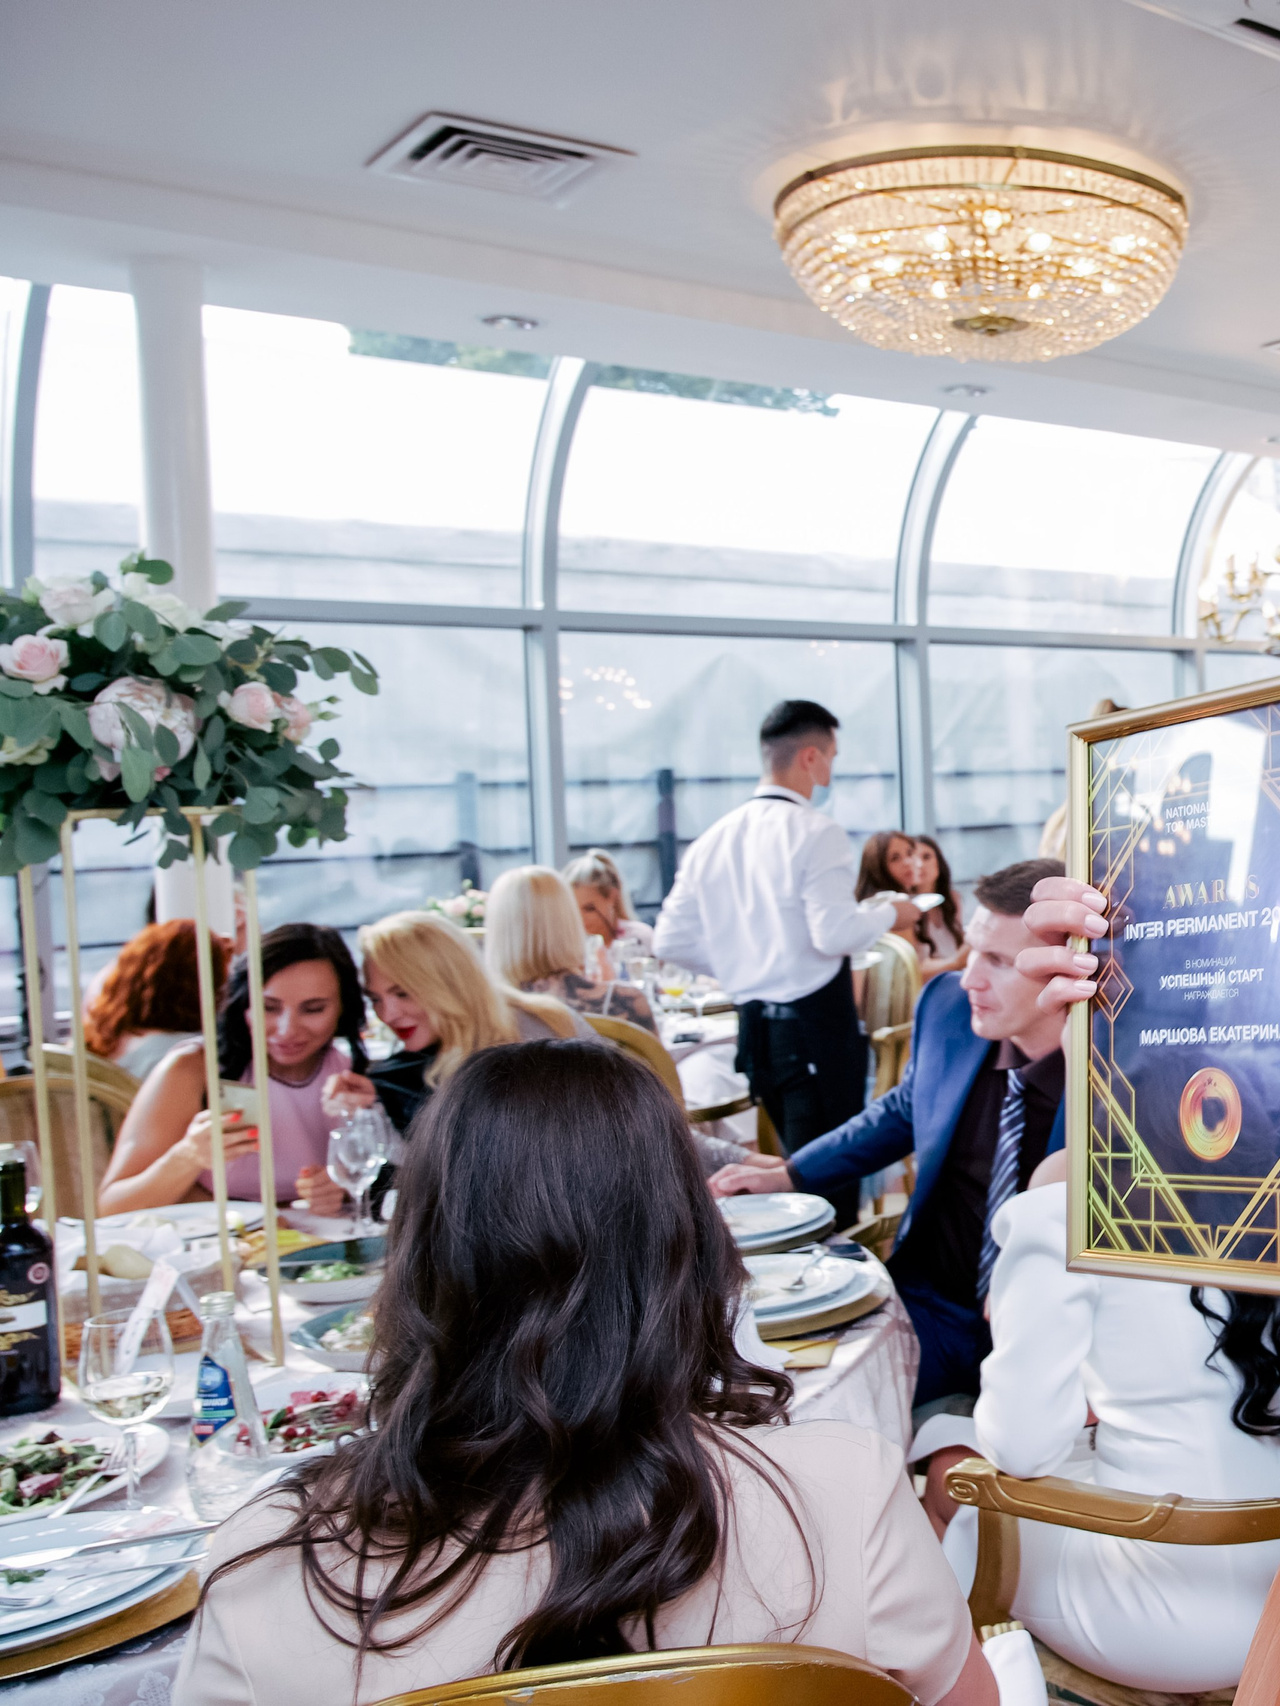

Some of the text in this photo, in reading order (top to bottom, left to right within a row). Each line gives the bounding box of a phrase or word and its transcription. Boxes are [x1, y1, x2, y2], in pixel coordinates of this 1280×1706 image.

[1165, 801, 1211, 819] NATIONAL
[1166, 820, 1184, 833] TOP
[1162, 874, 1260, 909] AWARS
[1125, 920, 1164, 940] INTER
[1167, 911, 1259, 937] PERMANENT
[1191, 956, 1237, 969] НОМИНАЦИИ
[1161, 968, 1264, 989] УСПЕШНЫЙ СТАРТ
[1184, 988, 1240, 1001] НАГРАЖДАЕТСЯ
[1140, 1027, 1207, 1045] МАРШОВА
